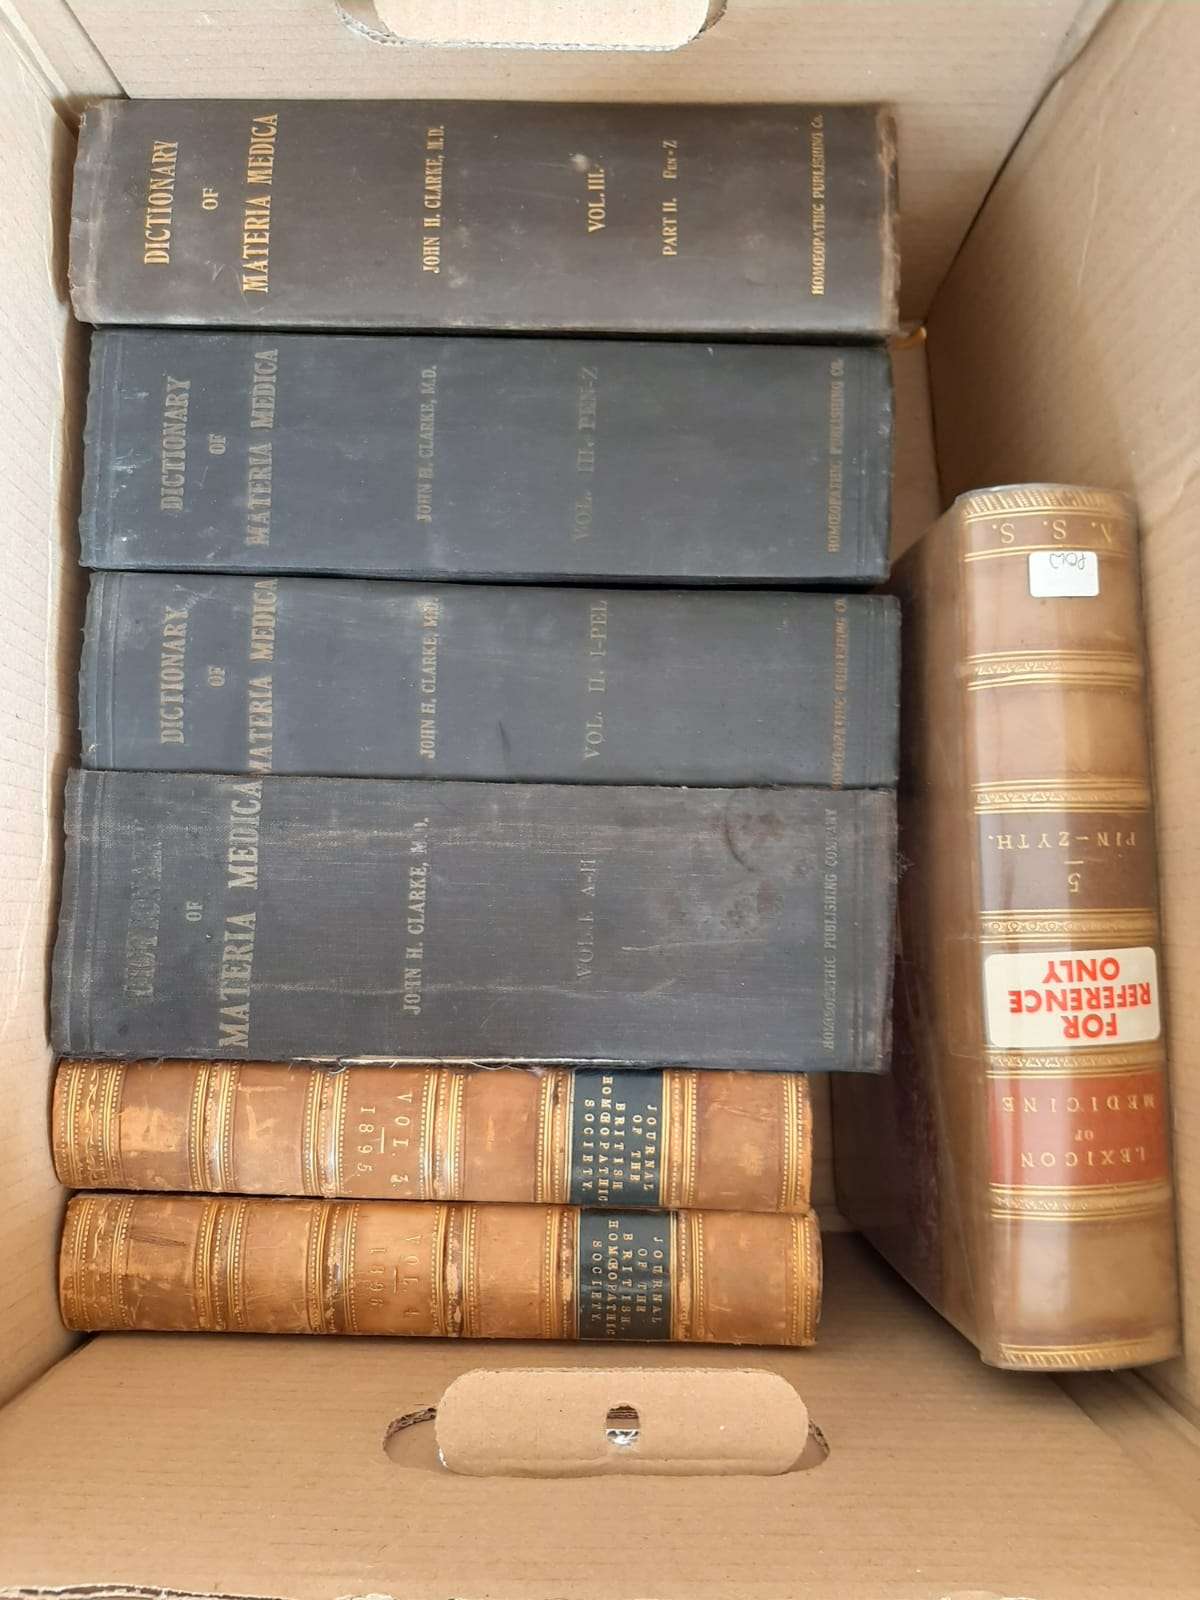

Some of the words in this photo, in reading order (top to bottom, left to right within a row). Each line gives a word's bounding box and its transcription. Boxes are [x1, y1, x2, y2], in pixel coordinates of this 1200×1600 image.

[247, 113, 278, 185] MEDICA
[426, 126, 444, 150] M.D.
[424, 156, 444, 208] CLARKE,
[812, 133, 824, 198] PUBLISHING
[144, 140, 178, 264] DICTIONARY
[202, 188, 218, 210] OF
[663, 198, 677, 212] II.
[424, 214, 440, 227] H.
[663, 217, 677, 255] PART
[243, 195, 271, 292] MATERIA
[423, 237, 440, 273] JOHN
[250, 348, 278, 429] MEDICA
[421, 366, 437, 394] M.D.
[160, 376, 191, 511] DICTIONARY
[209, 433, 226, 455] OF
[418, 400, 437, 458] CLARKE,
[245, 442, 272, 547] MATERIA
[416, 484, 433, 523] JOHN
[992, 522, 1015, 543] S.
[1043, 519, 1067, 539] S.
[250, 578, 278, 661] MEDICA
[161, 605, 188, 744] DICTIONARY
[208, 665, 226, 687] OF
[421, 633, 439, 693] CLARKE,
[588, 671, 605, 692] II.
[421, 699, 436, 713] H.
[419, 720, 436, 759] JOHN
[584, 712, 604, 758] VOL.
[228, 779, 263, 889] MEDICA
[407, 861, 429, 935] CLARKE,
[1068, 872, 1081, 892] 5
[186, 901, 203, 922] OF
[823, 874, 838, 950] PUBLISHING
[406, 943, 424, 959] H.
[1042, 957, 1120, 983] ONLY
[219, 911, 257, 1048] MATERIA
[404, 967, 422, 1015] JOHN
[1008, 982, 1151, 1013] REFERENCE
[1060, 1013, 1118, 1038] FOR
[1001, 1094, 1155, 1111] MEDICINE
[392, 1091, 412, 1156] VOL.
[598, 1076, 613, 1201] HOMŒOPATHIC
[632, 1115, 642, 1135] OF
[1074, 1129, 1093, 1140] OF
[582, 1100, 594, 1191] SOCIETY.
[612, 1103, 625, 1190] BRITISH
[643, 1105, 657, 1191] JOURNAL
[1020, 1147, 1145, 1167] LEXICON
[630, 1151, 641, 1182] THE
[638, 1249, 647, 1270] OF
[636, 1282, 646, 1312] THE
[652, 1237, 663, 1322] JOURNAL
